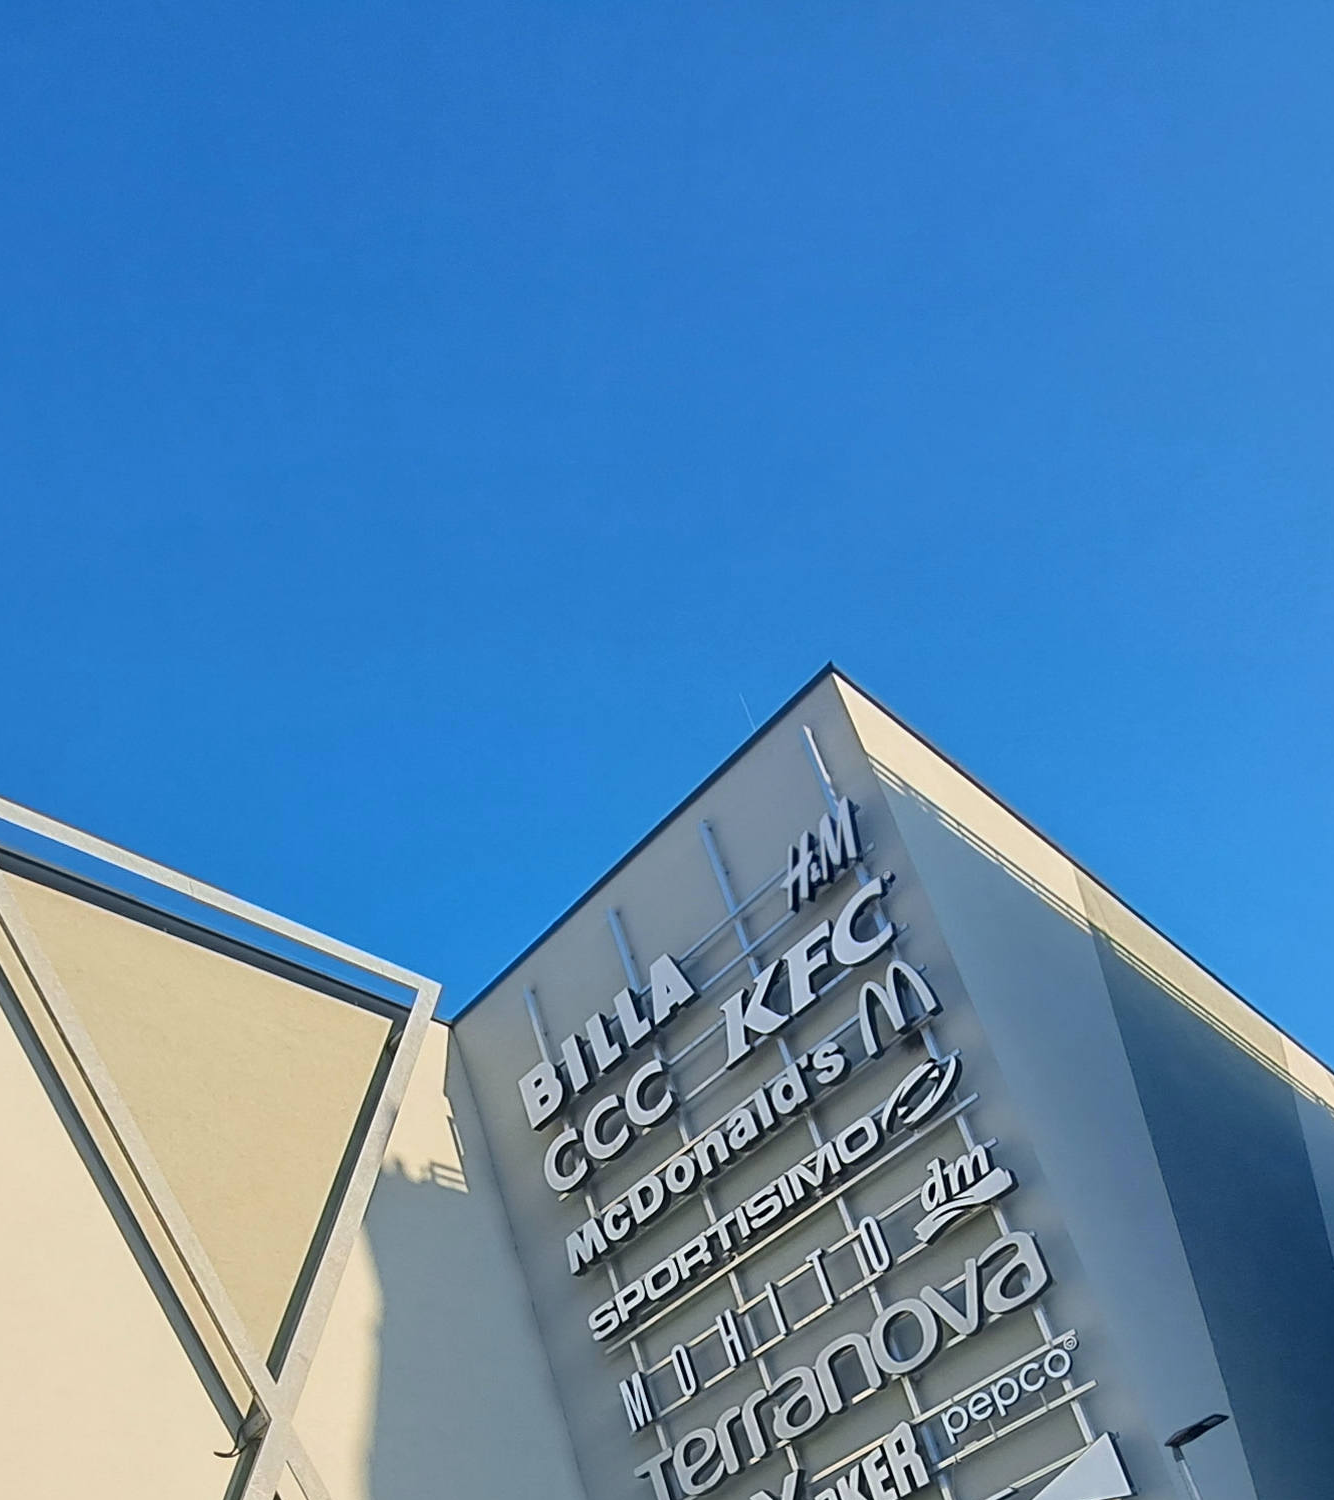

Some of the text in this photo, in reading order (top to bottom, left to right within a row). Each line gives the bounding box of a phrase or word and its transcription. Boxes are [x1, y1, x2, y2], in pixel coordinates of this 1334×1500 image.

[781, 797, 861, 909] H&M
[519, 954, 696, 1130] BILLA
[719, 875, 895, 1070] KFC
[543, 1061, 673, 1194] CCC
[567, 1041, 848, 1275] McDonald's
[921, 1145, 989, 1209] dm
[588, 1114, 879, 1341] SPORTISIMO
[620, 1217, 891, 1433] MOHITO
[941, 1353, 1072, 1444] pepco
